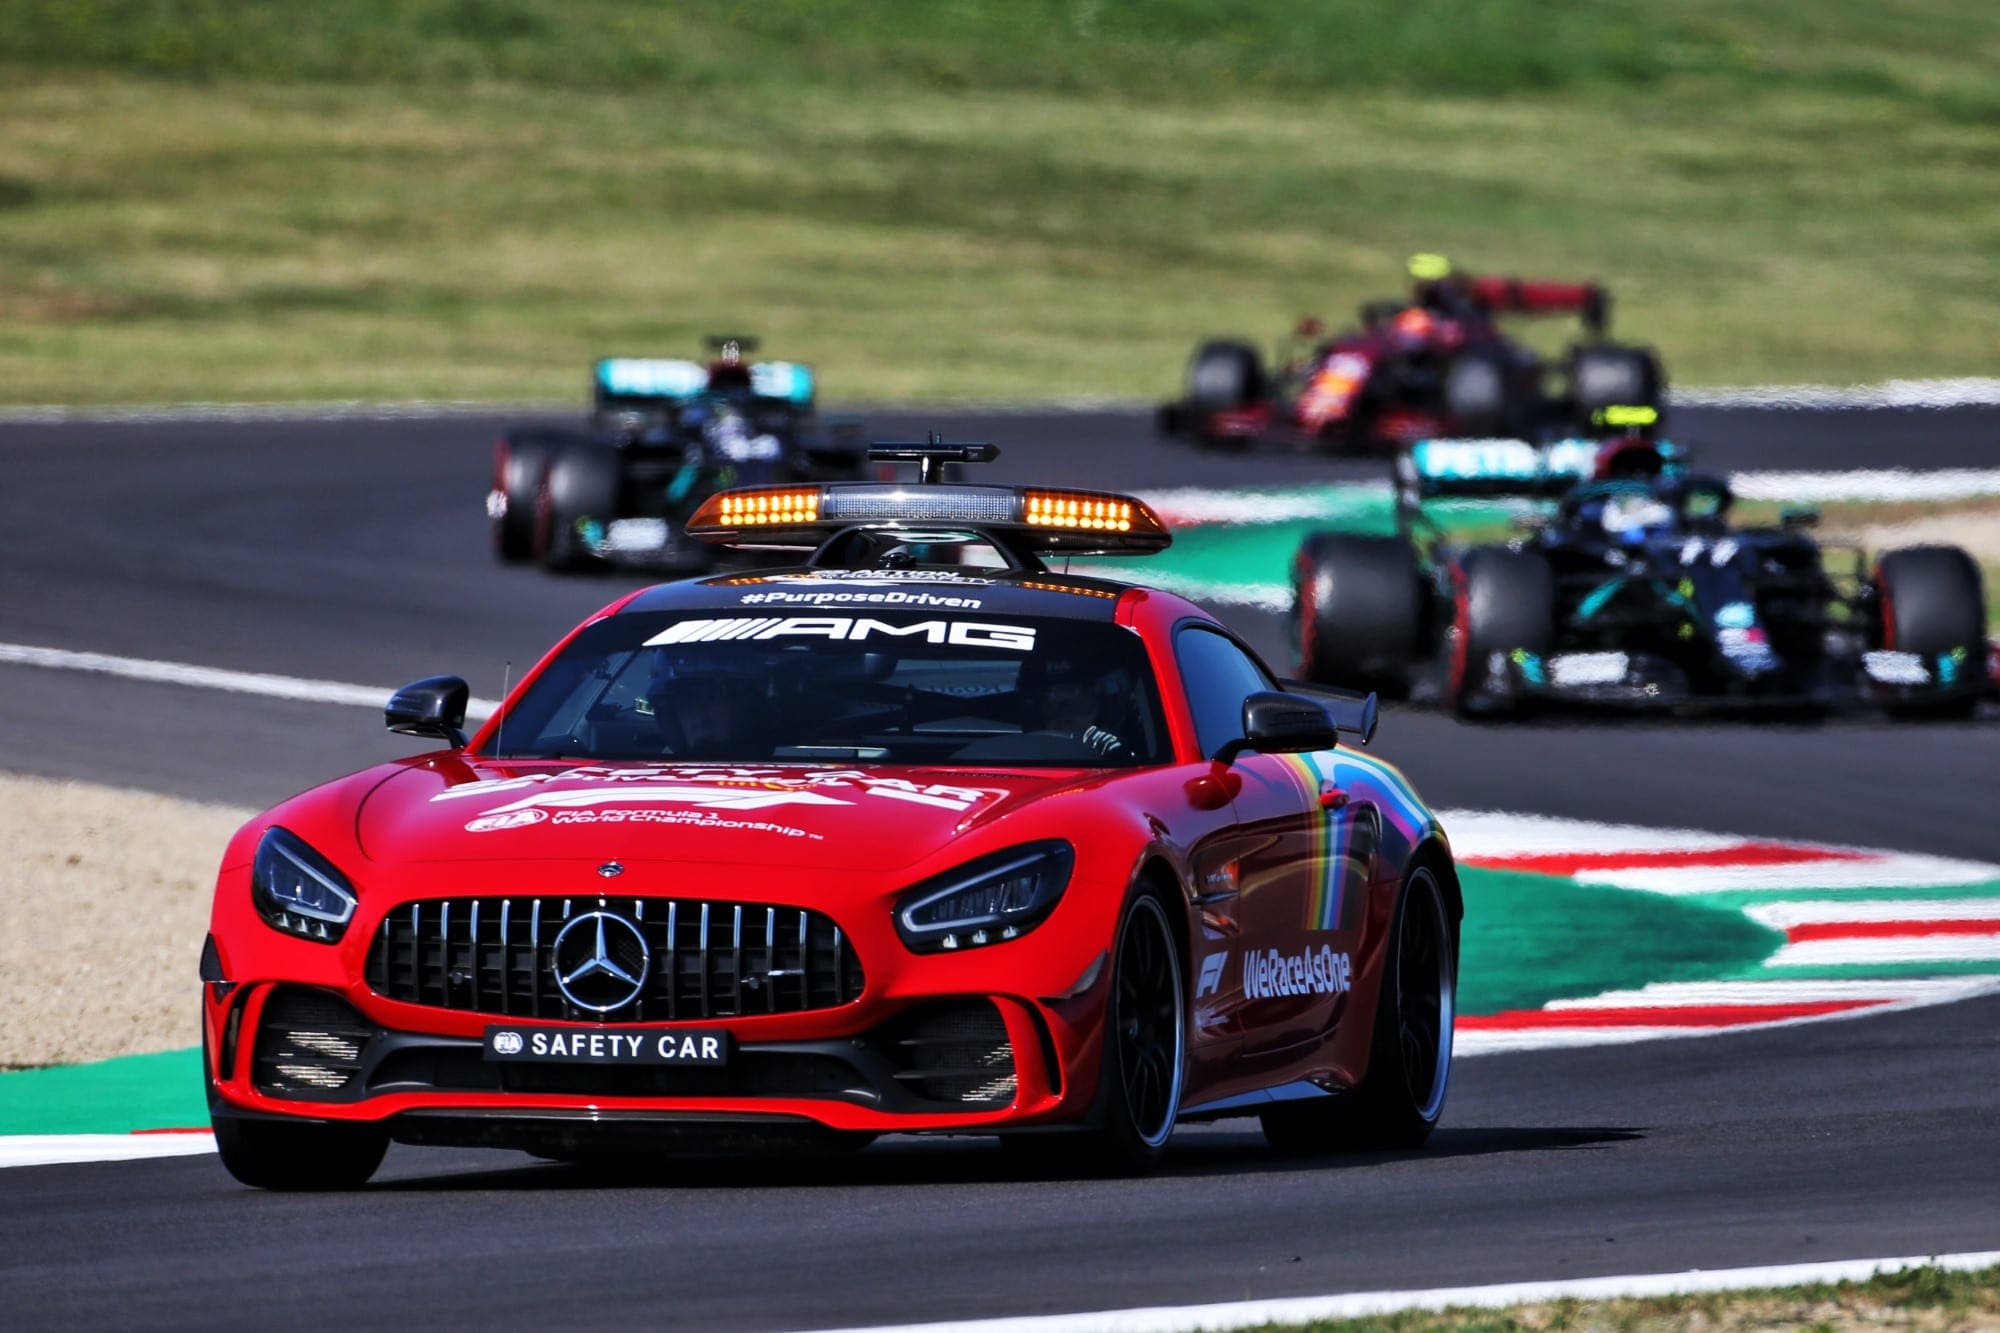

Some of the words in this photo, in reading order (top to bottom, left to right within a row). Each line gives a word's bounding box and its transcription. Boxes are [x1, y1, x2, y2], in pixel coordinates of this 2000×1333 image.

[740, 591, 982, 609] #PurposeDriven
[551, 814, 626, 825] World
[629, 814, 806, 837] Championship
[554, 810, 596, 818] FIA
[600, 809, 703, 820] Formula
[705, 812, 719, 820] 1
[1243, 944, 1351, 1000] WeRaceAsOne
[495, 1034, 521, 1053] FIA
[531, 1032, 645, 1058] SAFETY
[657, 1035, 720, 1060] CAR
